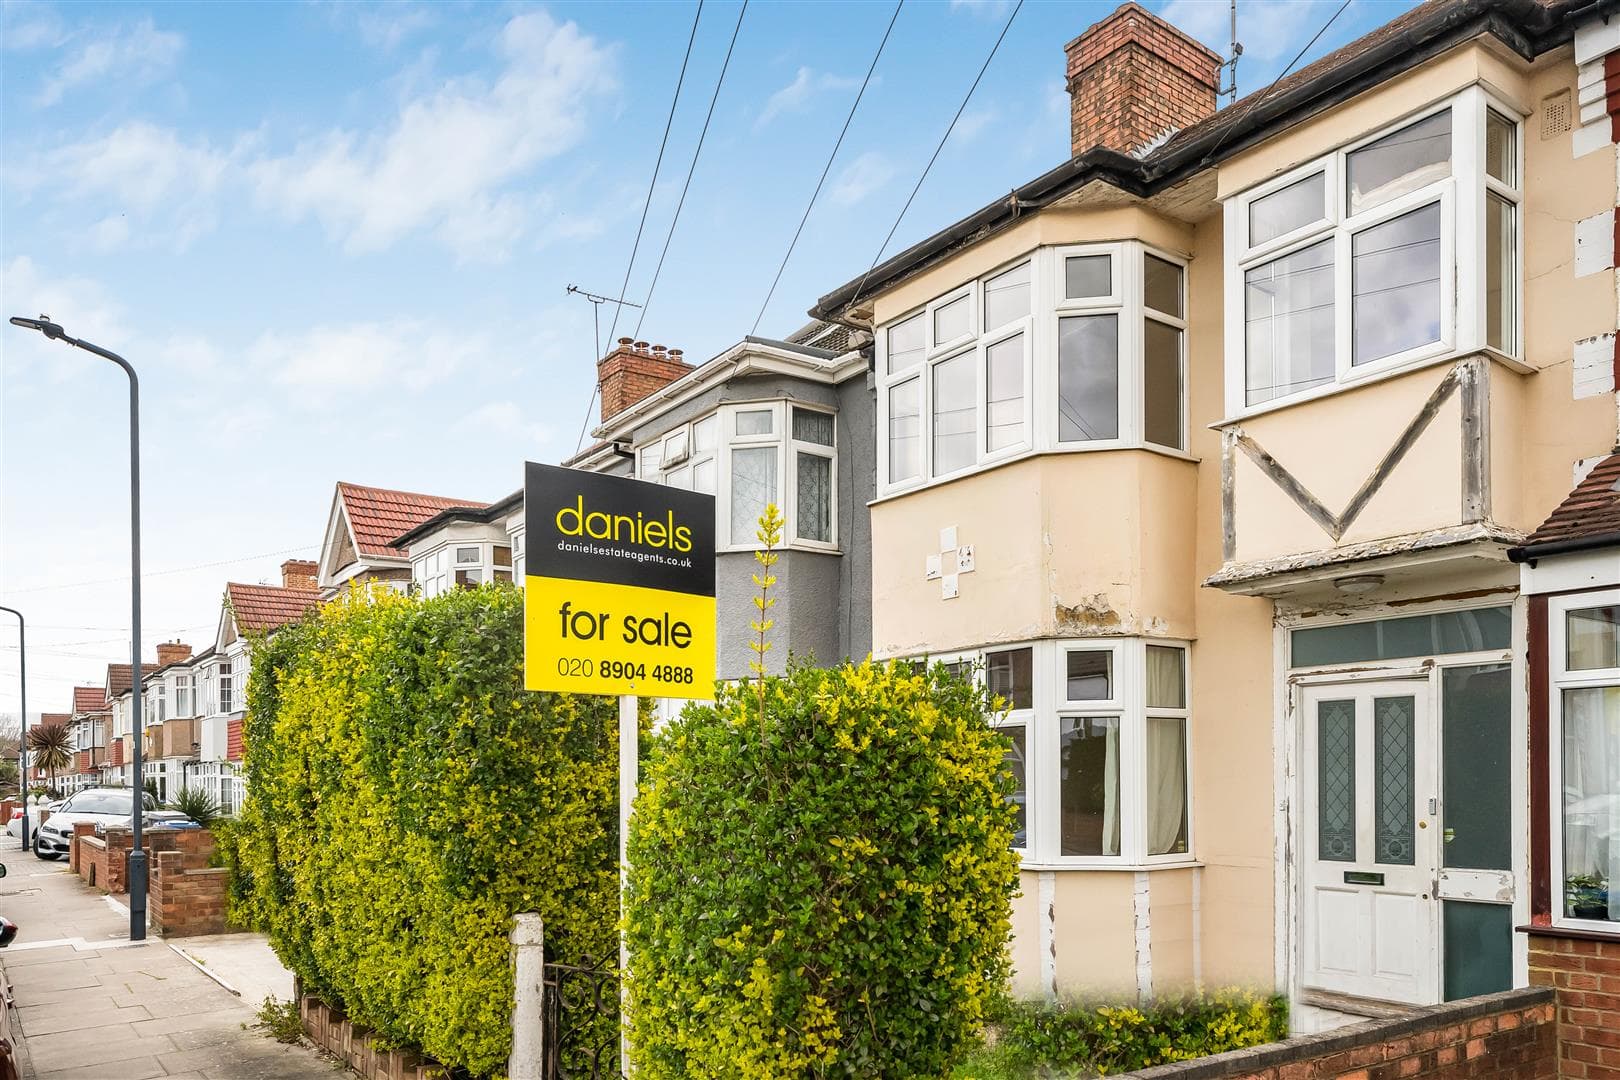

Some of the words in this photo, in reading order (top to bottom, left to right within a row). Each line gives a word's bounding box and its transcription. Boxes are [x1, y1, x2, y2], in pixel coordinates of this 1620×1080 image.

[555, 495, 693, 552] daniels
[557, 540, 692, 568] danielsestateagents.co.uk
[559, 601, 610, 641] for
[622, 612, 692, 649] sale
[557, 657, 594, 678] 020
[599, 660, 647, 681] 8904
[651, 664, 694, 684] 4888
